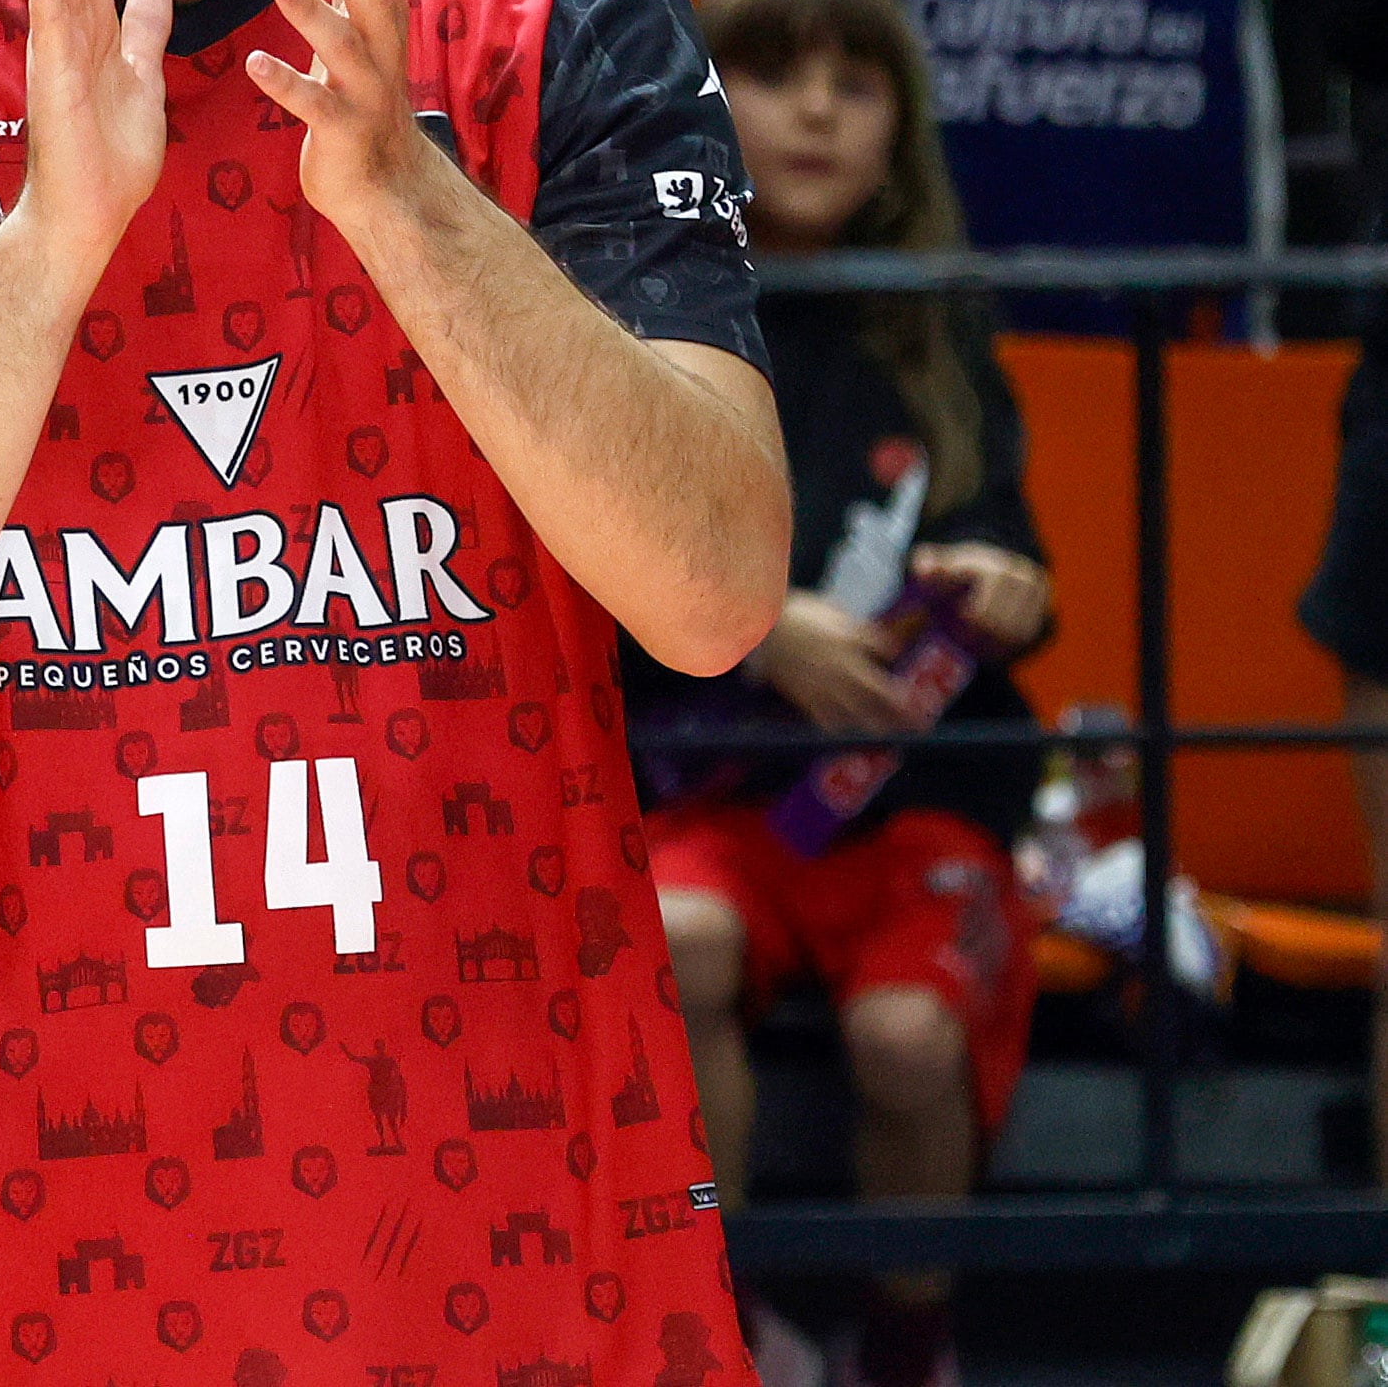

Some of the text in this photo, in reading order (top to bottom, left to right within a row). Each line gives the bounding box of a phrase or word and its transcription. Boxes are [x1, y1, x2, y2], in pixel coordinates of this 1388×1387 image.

[927, 52, 1207, 130] sfuerzo
[177, 378, 255, 405] 1900
[232, 634, 464, 669] CERVECEROS
[137, 757, 383, 969] 14
[207, 1228, 286, 1272] ZGZ
